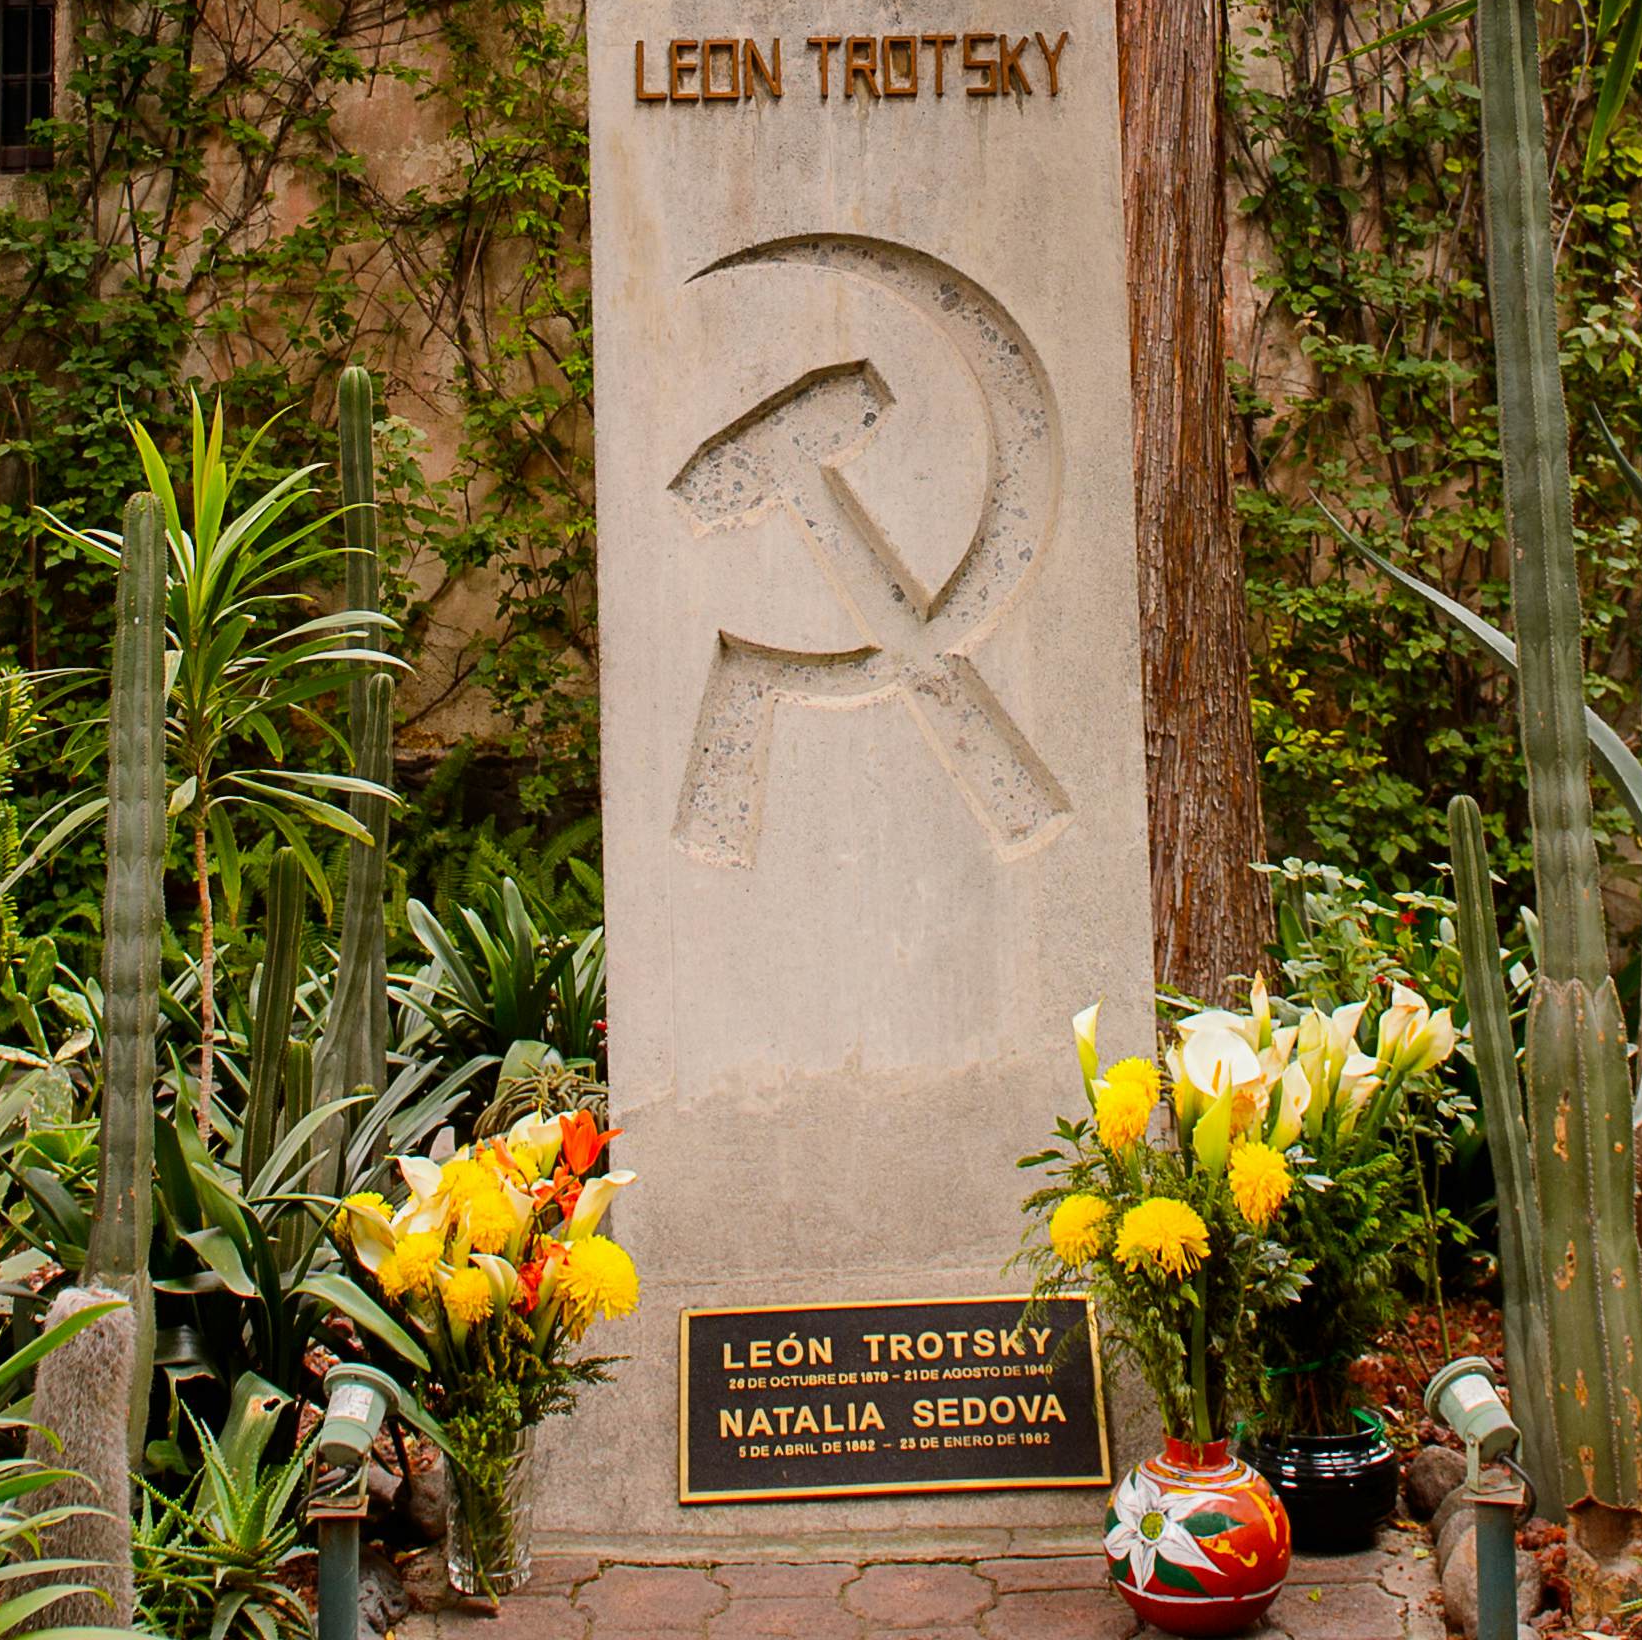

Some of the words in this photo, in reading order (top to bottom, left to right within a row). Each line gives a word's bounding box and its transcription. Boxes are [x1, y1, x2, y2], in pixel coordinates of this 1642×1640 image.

[635, 38, 783, 101] LEON
[806, 31, 1069, 98] TROTSKY
[723, 1332, 833, 1370] LEÓN
[863, 1327, 1052, 1362] TROTSKY
[747, 1377, 767, 1390] DE
[770, 1373, 836, 1388] OCTUBRE
[838, 1372, 858, 1385] DE
[904, 1369, 917, 1382] 21
[920, 1369, 939, 1380] DE
[942, 1366, 1001, 1380] AGOSTO
[1003, 1365, 1022, 1377] DE
[720, 1401, 886, 1438] NATALIA
[912, 1393, 1067, 1428] SEDOVA
[739, 1446, 746, 1458] 5
[750, 1445, 770, 1457] DE
[773, 1442, 818, 1457] ABRIL
[822, 1441, 842, 1454] DE
[920, 1437, 940, 1449] DE
[944, 1434, 994, 1448] ENERO
[997, 1433, 1016, 1446] DE
